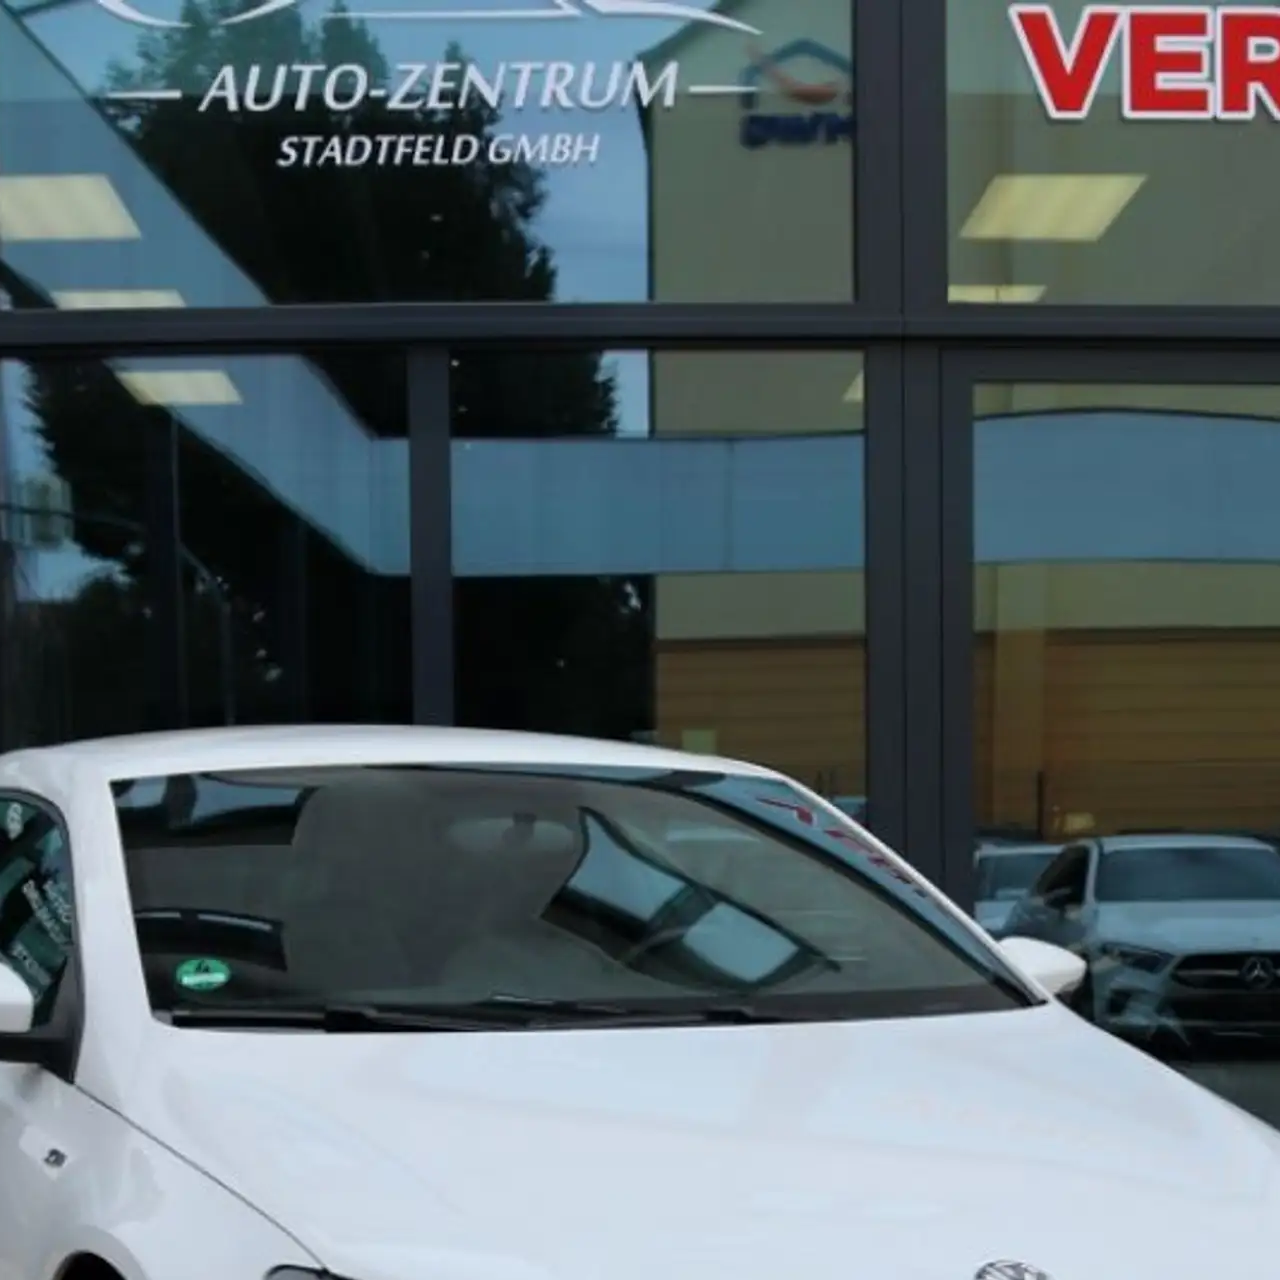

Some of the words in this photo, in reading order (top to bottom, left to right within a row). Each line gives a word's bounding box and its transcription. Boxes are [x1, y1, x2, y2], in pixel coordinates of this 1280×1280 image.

[198, 60, 679, 113] AUTO-ZENTRUM
[276, 134, 478, 168] STADTFELD
[487, 132, 600, 165] GMBH
